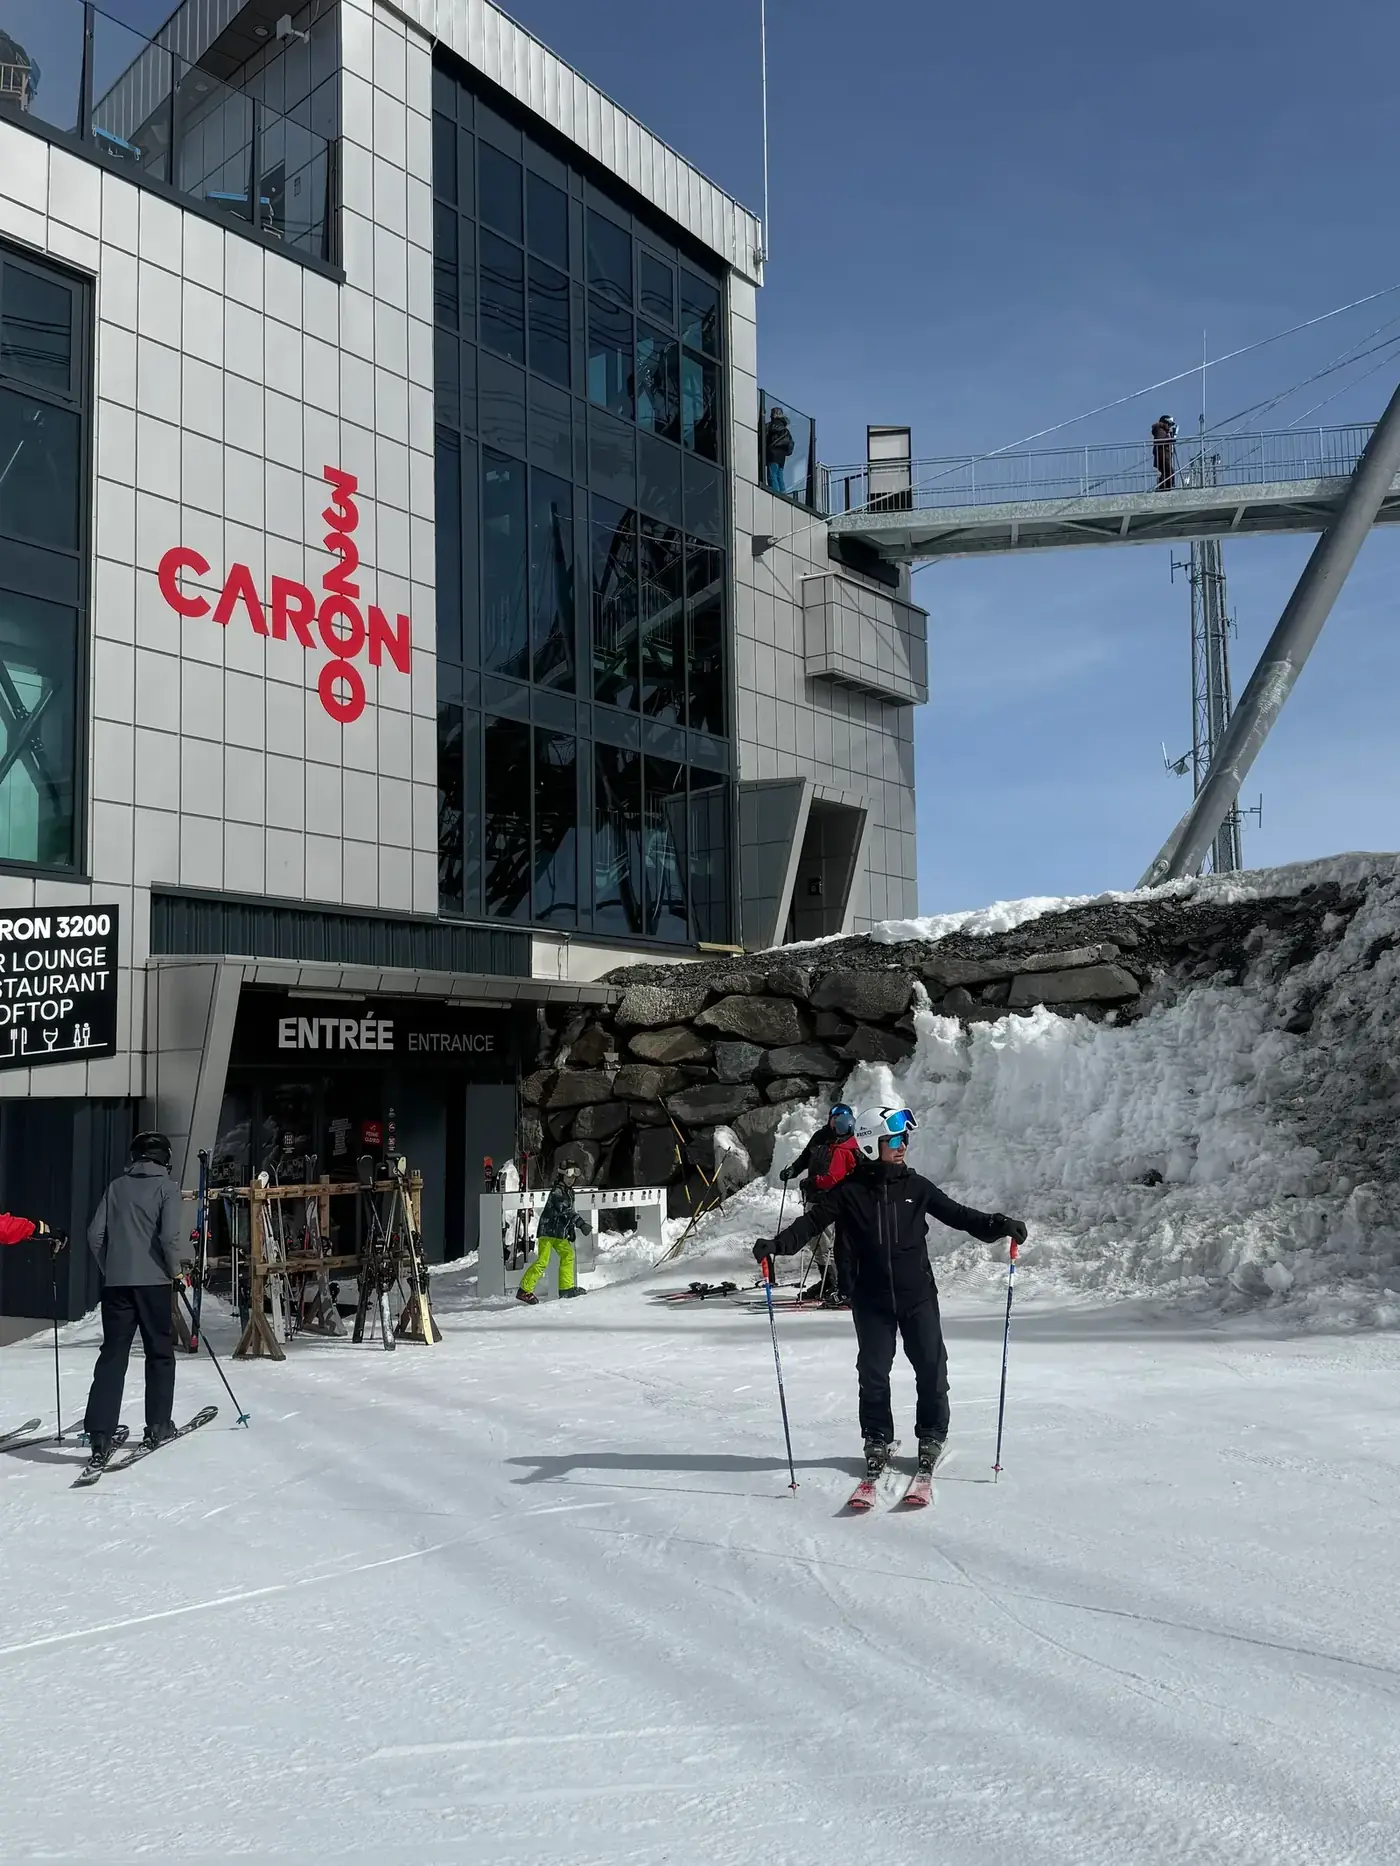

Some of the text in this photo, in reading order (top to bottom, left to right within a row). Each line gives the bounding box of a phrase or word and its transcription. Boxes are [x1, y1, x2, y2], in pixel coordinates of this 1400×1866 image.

[158, 546, 410, 674] CARON
[318, 464, 366, 723] 3200
[56, 914, 110, 938] 3200
[13, 947, 106, 972] LOUNGE
[0, 971, 109, 998] TAURANT
[278, 1011, 494, 1052] ENTRÉE ENTRANCE
